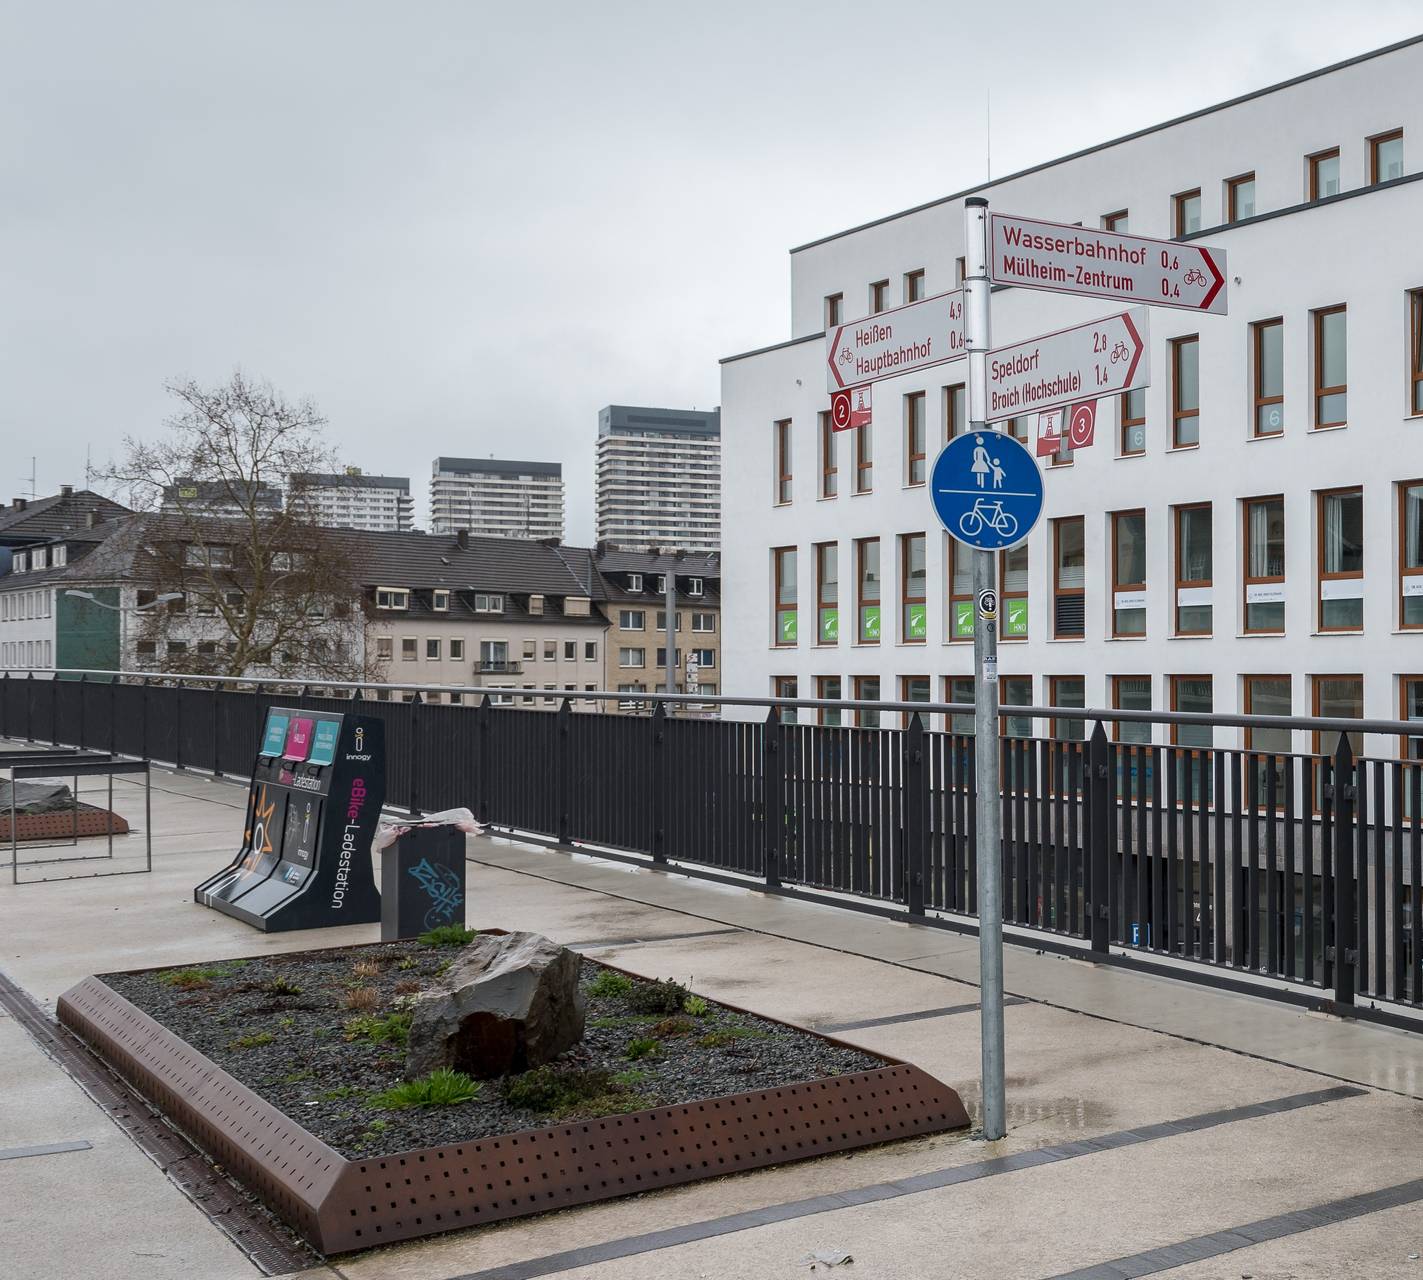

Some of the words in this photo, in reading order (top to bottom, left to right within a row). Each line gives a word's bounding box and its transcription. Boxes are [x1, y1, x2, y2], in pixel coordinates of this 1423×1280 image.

[1003, 225, 1147, 265] Wasserbahnhof
[1003, 255, 1134, 292] Mülheim-Zentrum
[856, 324, 892, 349] Heißen
[856, 337, 932, 376] Hauptbahnhof
[991, 348, 1040, 384] Speldorf
[992, 386, 1020, 411] Broich
[1022, 369, 1081, 406] (Hochschule)
[838, 405, 845, 418] 2
[1078, 418, 1086, 433] 3
[914, 627, 926, 635] HNO
[962, 625, 974, 633] HNO
[346, 752, 372, 761] innogy
[331, 777, 367, 910] eBike-Ladestation
